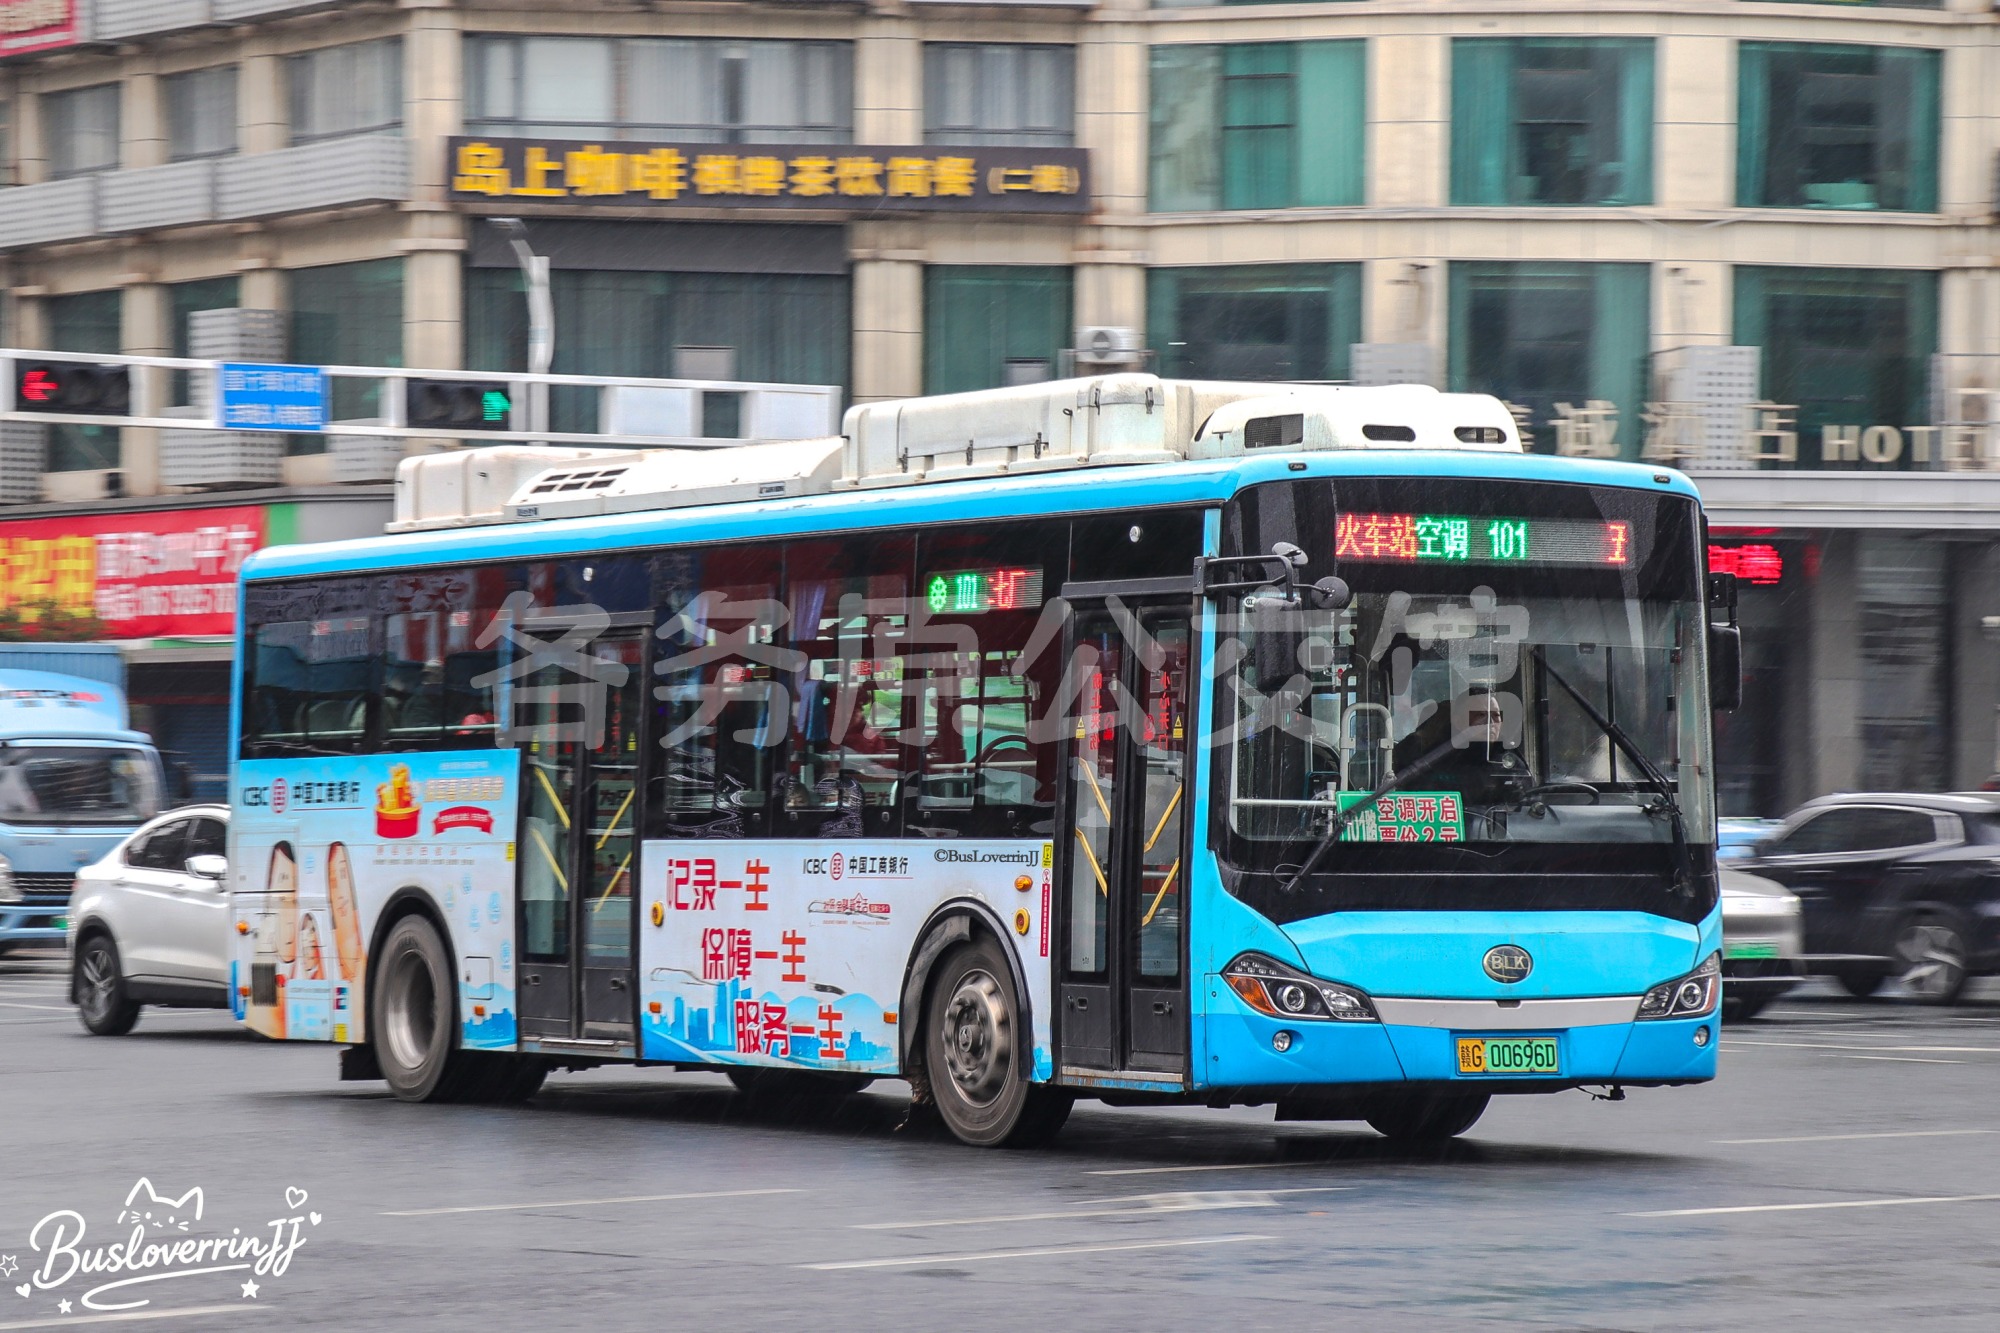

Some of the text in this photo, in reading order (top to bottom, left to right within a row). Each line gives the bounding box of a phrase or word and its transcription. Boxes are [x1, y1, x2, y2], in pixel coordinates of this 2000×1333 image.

[1488, 521, 1527, 559] 101
[1377, 796, 1459, 823] 空调开启
[802, 857, 828, 875] ICBC
[667, 858, 770, 911] 记录一生
[701, 927, 807, 982] 保障一生
[1491, 955, 1528, 970] BLK
[734, 999, 845, 1060] 服务一生
[1491, 1044, 1556, 1068] 00696D
